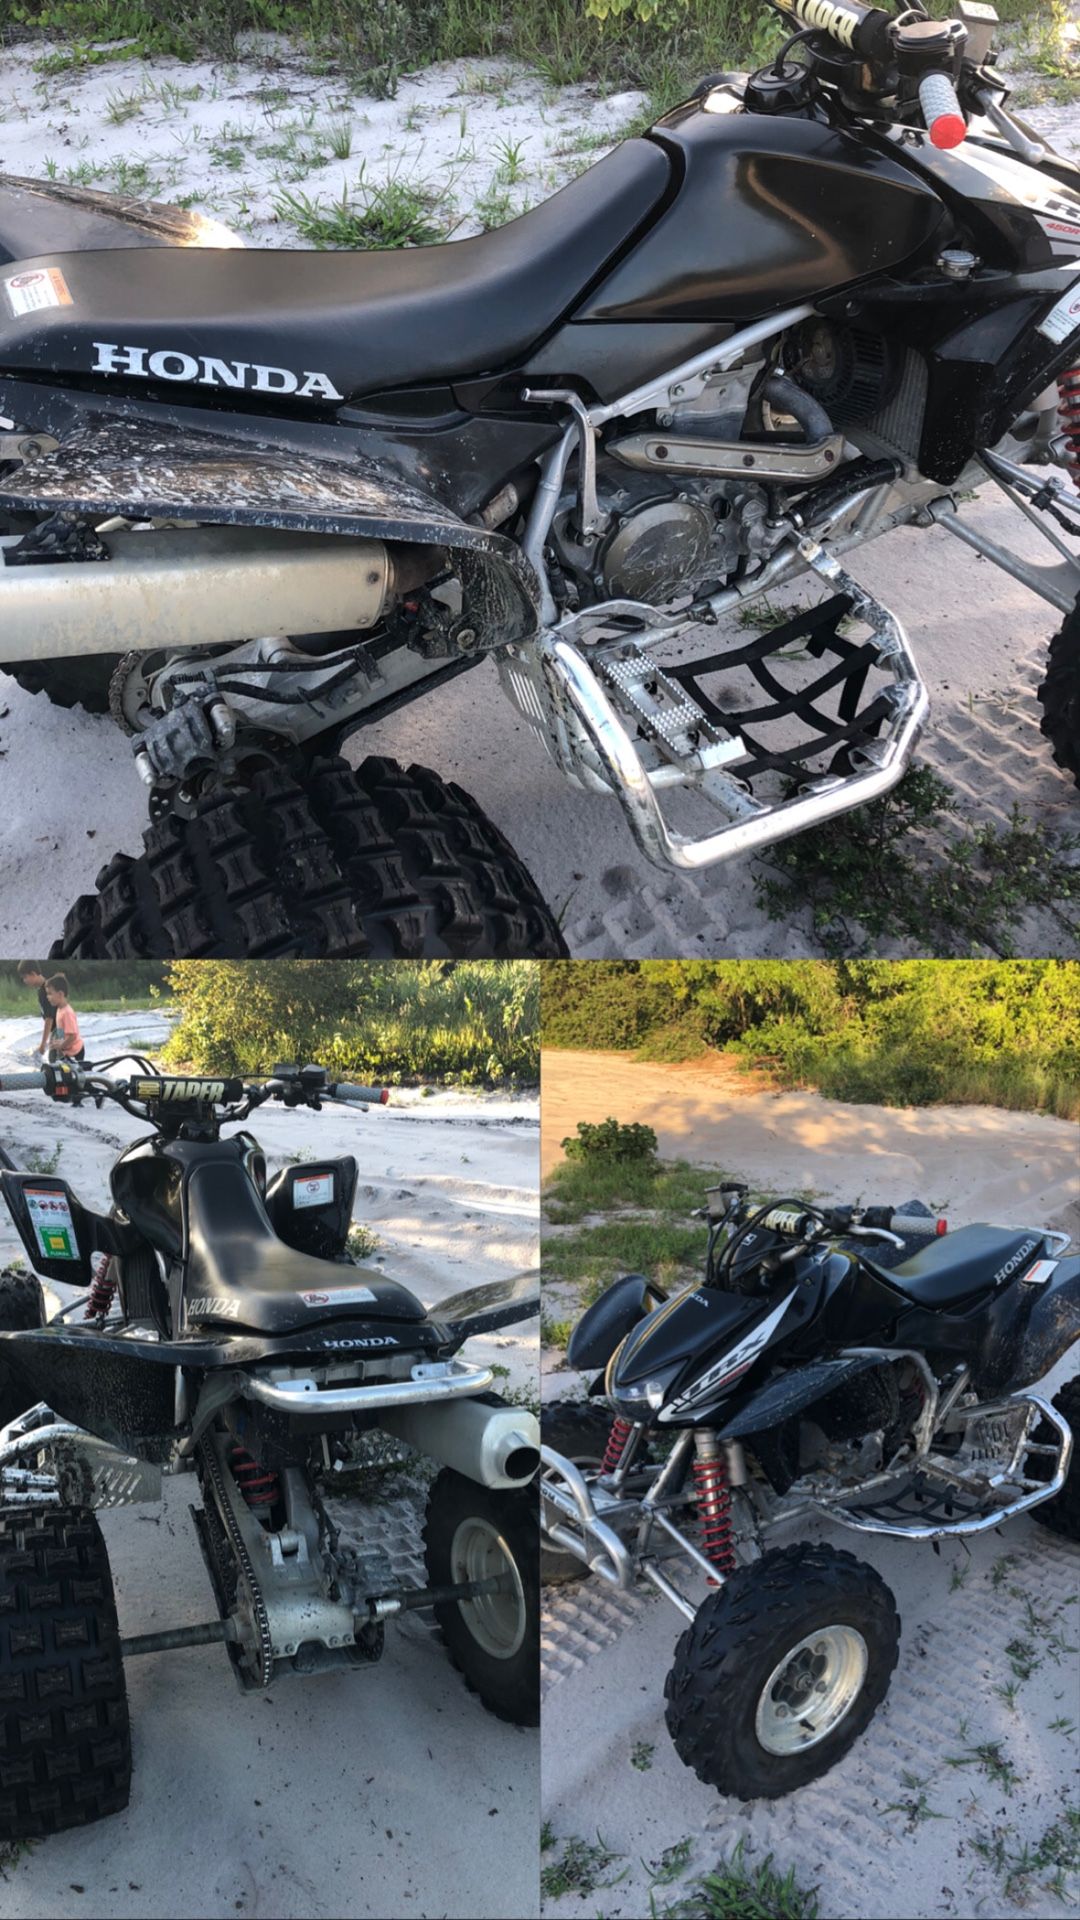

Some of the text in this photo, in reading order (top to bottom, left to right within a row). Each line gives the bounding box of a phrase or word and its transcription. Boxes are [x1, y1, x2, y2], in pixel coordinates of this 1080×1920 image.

[91, 342, 344, 400] HONDA
[163, 1081, 225, 1102] TAPER
[759, 1209, 801, 1233] APER
[993, 1239, 1037, 1285] HONDA
[187, 1297, 240, 1318] HONDA
[323, 1335, 400, 1348] HONDA
[686, 1331, 767, 1397] TRX
